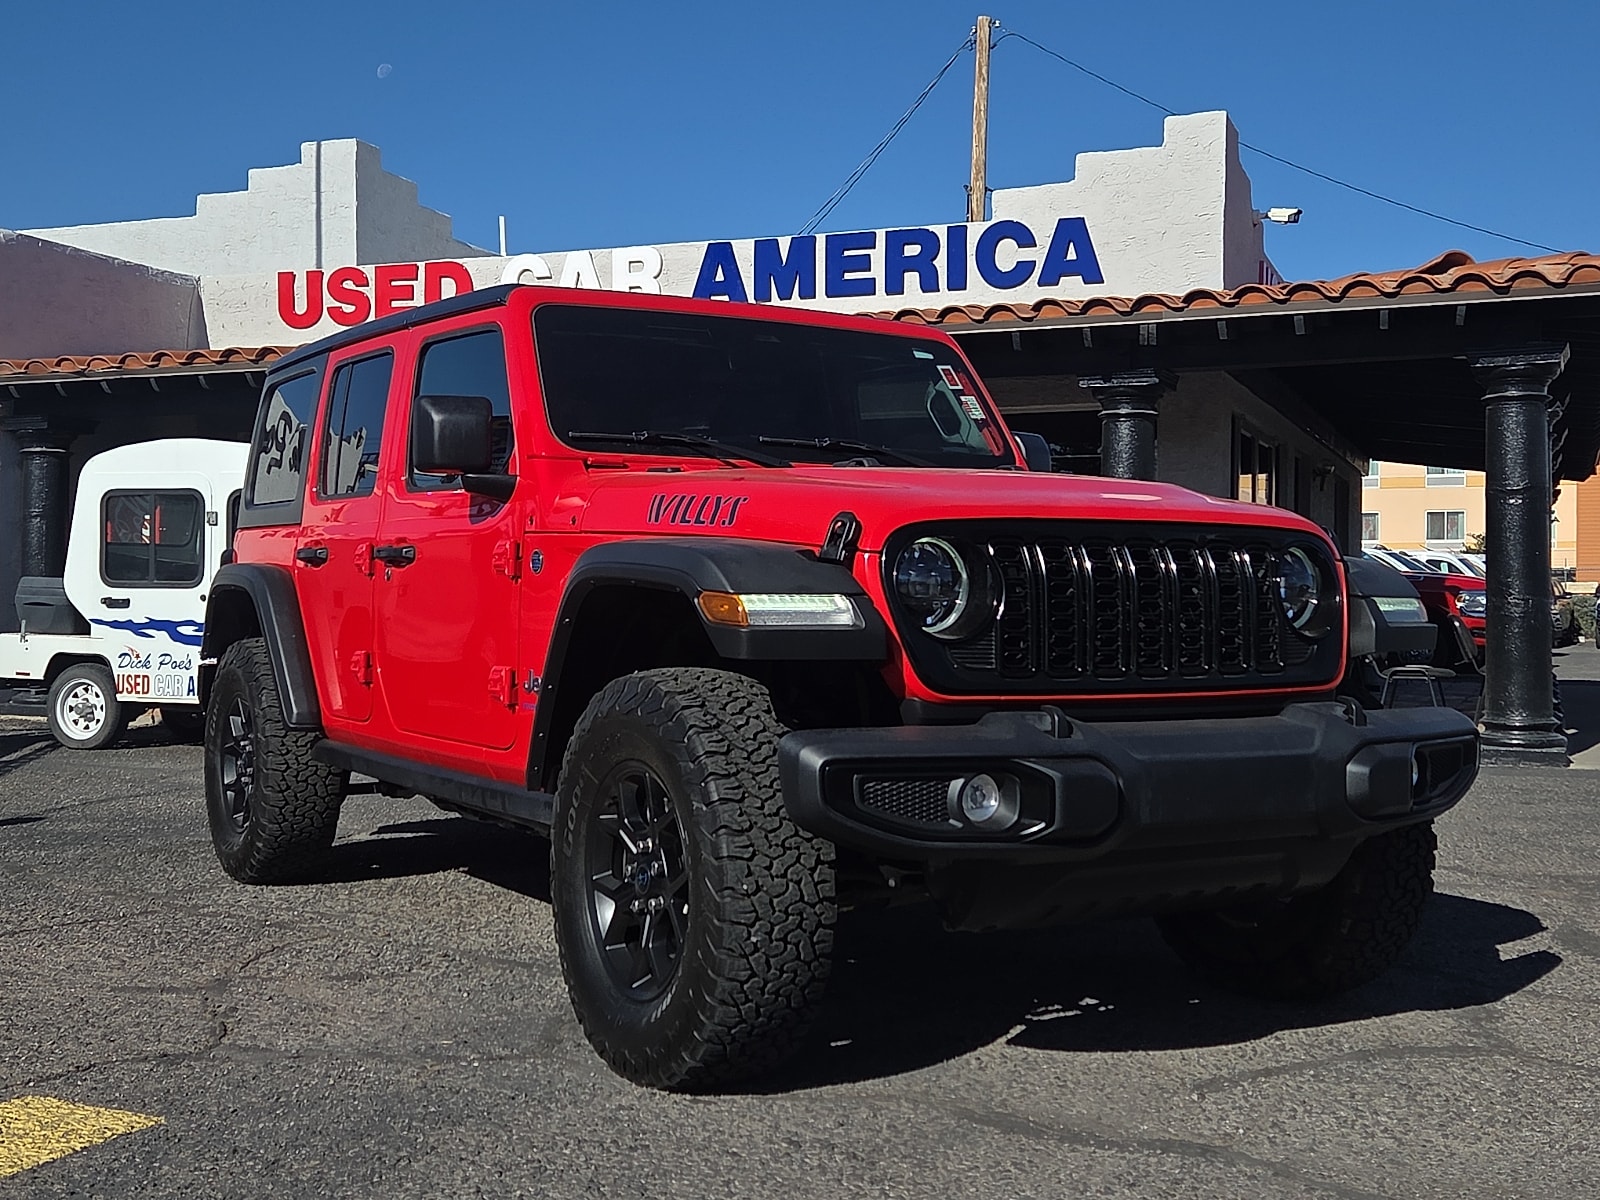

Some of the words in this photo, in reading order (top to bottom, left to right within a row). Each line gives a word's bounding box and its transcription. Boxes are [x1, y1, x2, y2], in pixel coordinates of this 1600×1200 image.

[277, 260, 474, 329] USED
[501, 246, 664, 294] CAR
[692, 216, 1105, 304] AMERICA
[647, 494, 749, 527] WILLYS
[118, 653, 152, 670] Dick
[157, 653, 193, 671] Poe's
[116, 674, 150, 695] USED
[154, 674, 184, 697] CAR
[187, 676, 199, 697] A
